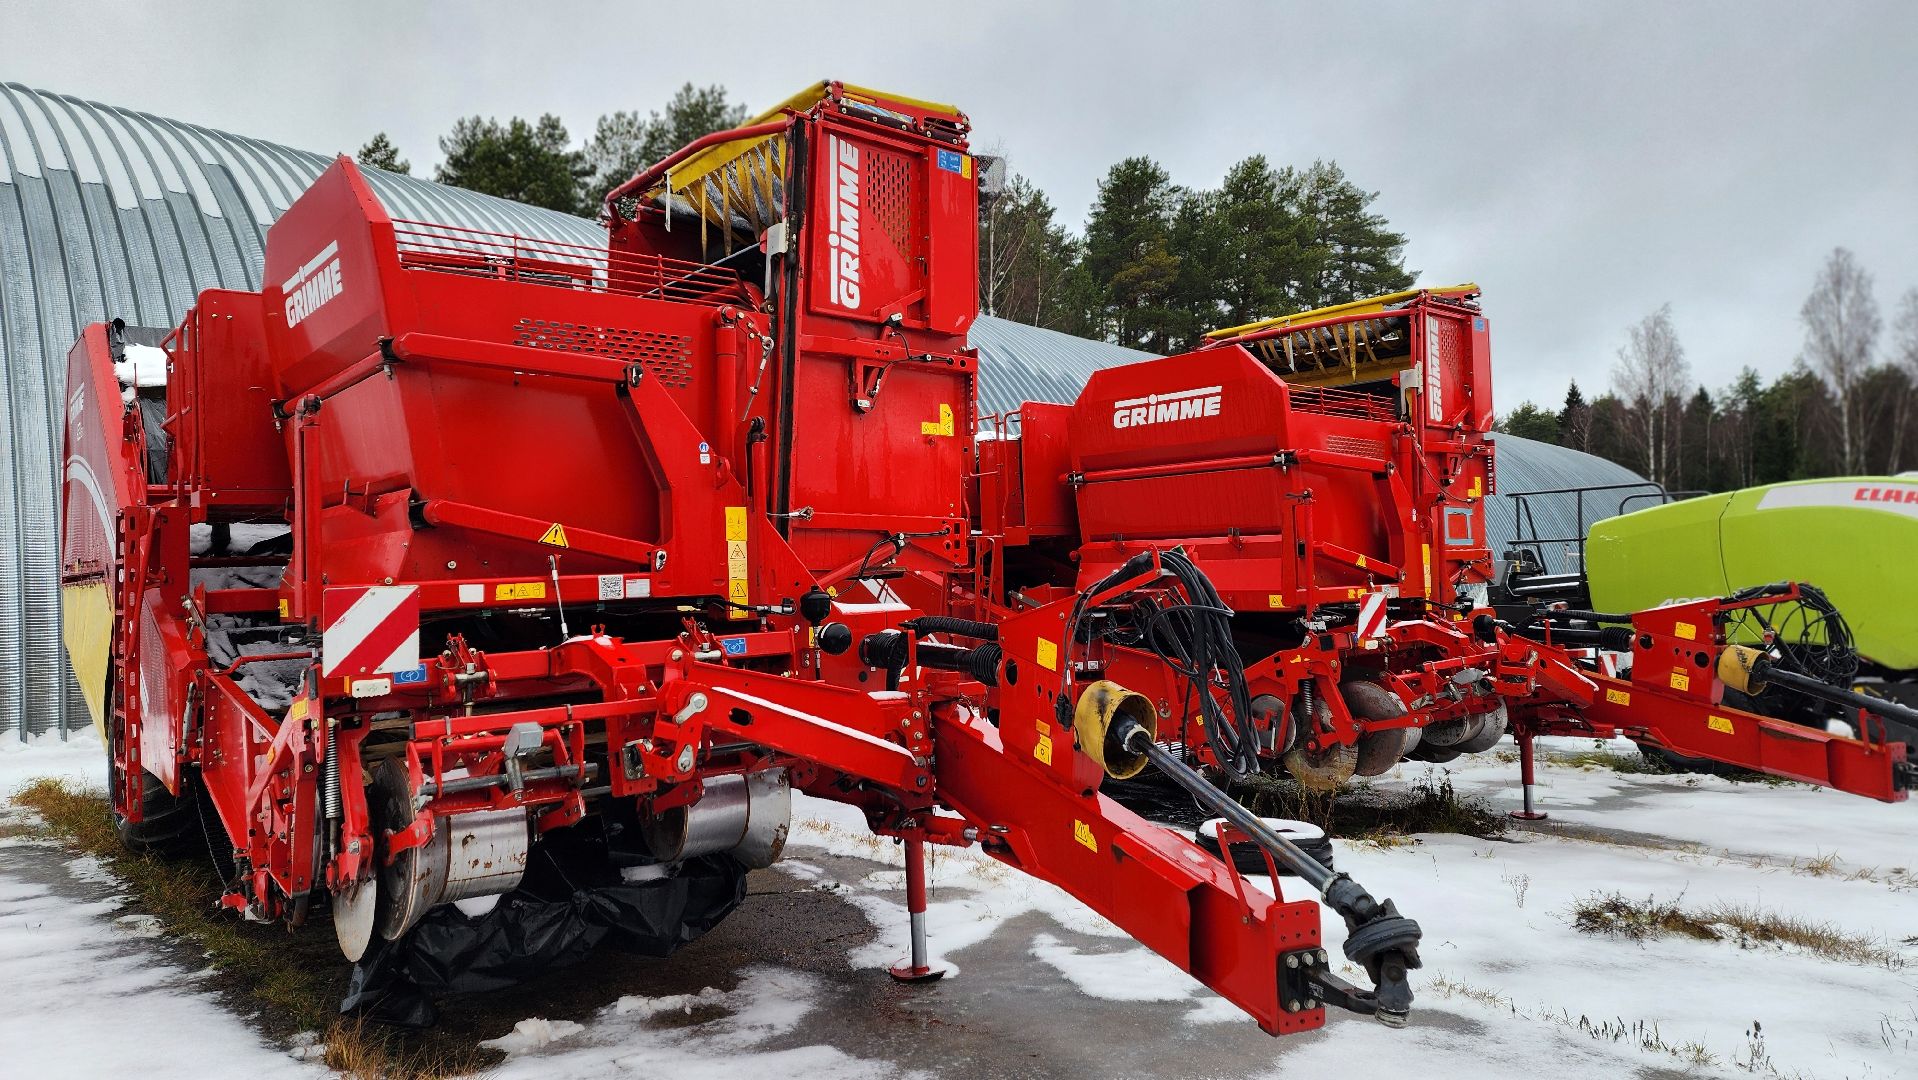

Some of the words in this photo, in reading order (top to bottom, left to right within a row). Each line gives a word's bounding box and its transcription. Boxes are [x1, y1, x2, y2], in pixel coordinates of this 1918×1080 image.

[829, 138, 861, 309] GRIMME
[284, 257, 343, 329] GRIMME
[1113, 393, 1222, 429] GRIMME
[1427, 314, 1443, 422] GRIMME
